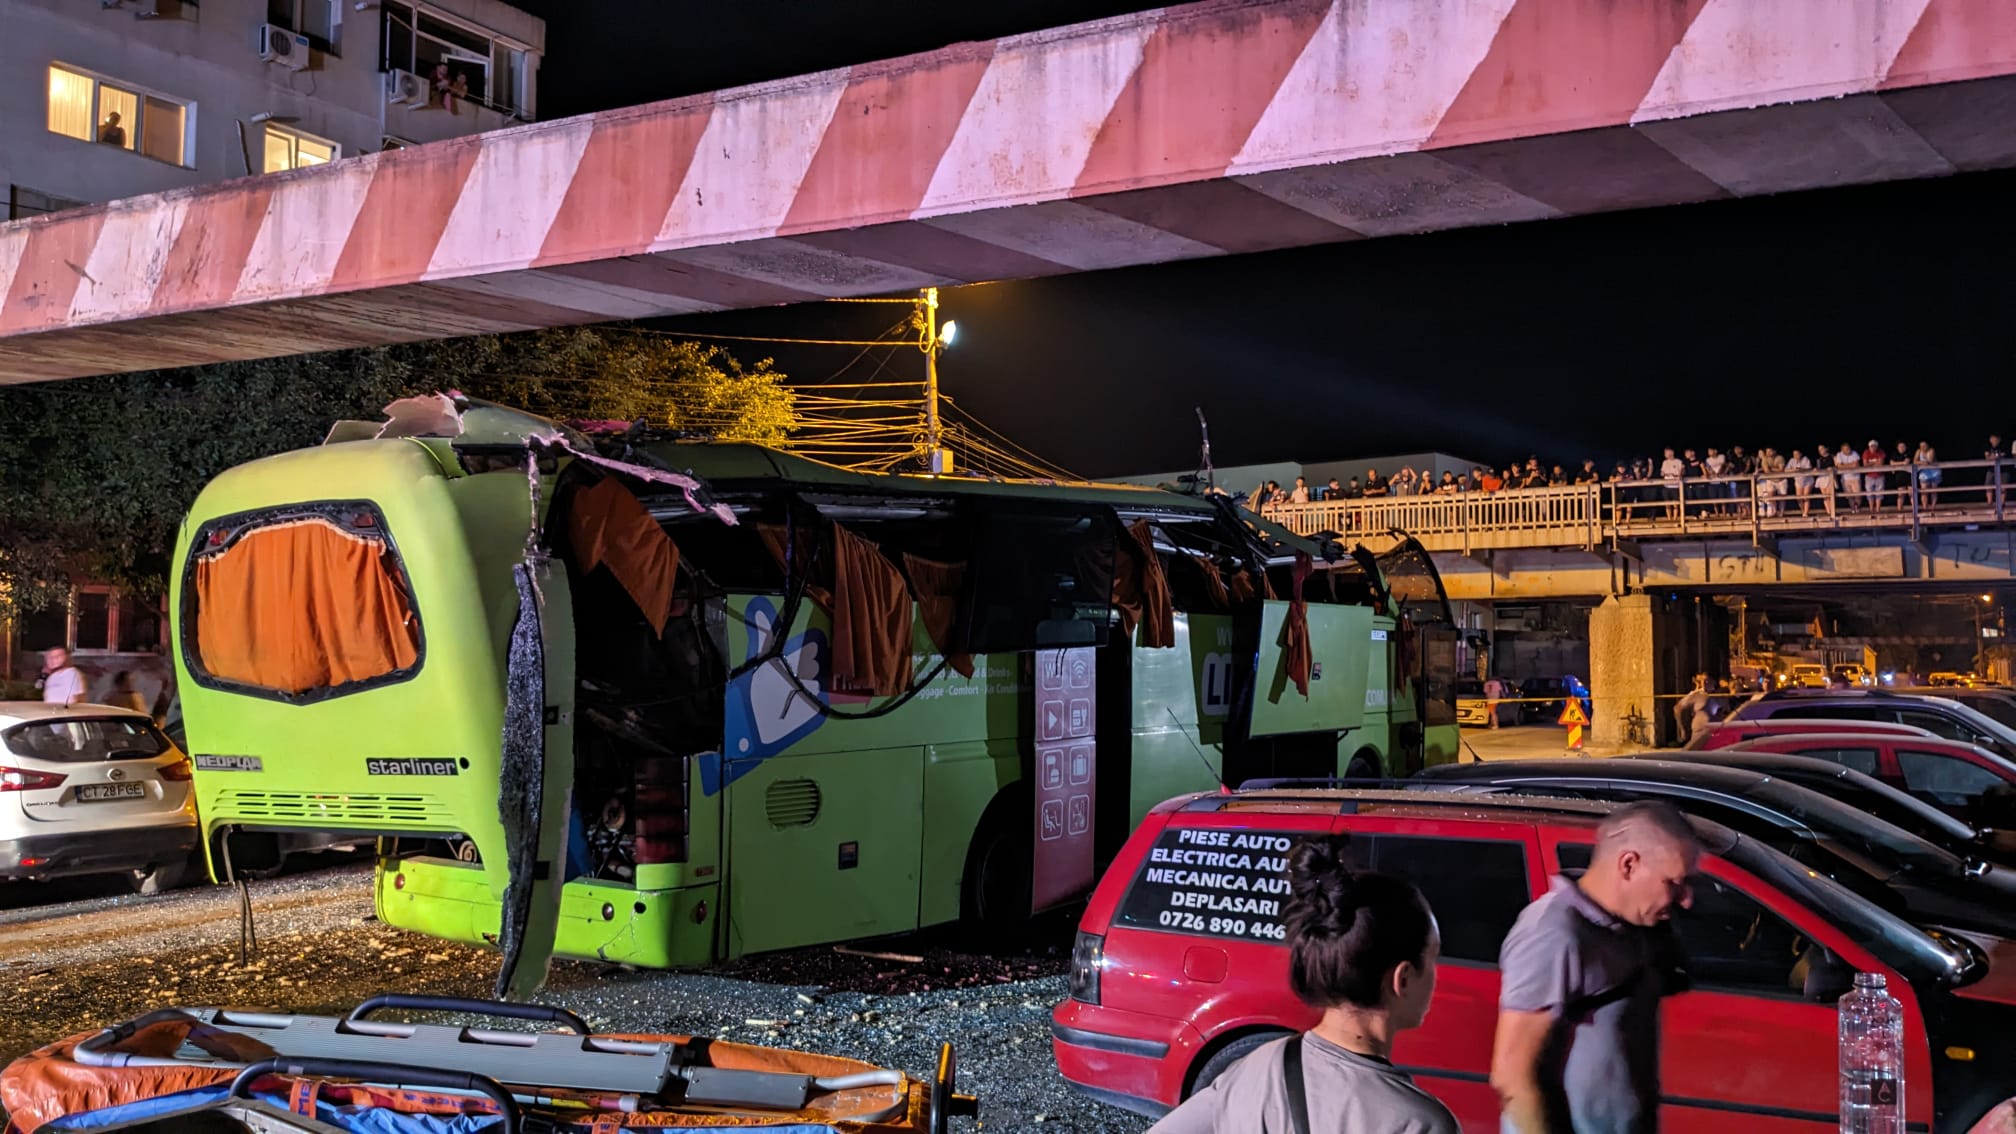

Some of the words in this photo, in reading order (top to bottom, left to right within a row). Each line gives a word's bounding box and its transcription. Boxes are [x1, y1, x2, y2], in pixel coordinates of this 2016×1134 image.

[948, 685, 979, 697] Comfort
[368, 758, 456, 775] starliner
[83, 786, 98, 799] CT
[1179, 830, 1231, 847] PIESE
[1232, 834, 1291, 852] AUTO
[1150, 848, 1252, 870] ELECTRICA
[1254, 856, 1291, 872] AU
[1146, 867, 1249, 891] MECANICA
[1251, 877, 1292, 895] AUT
[1170, 891, 1280, 916] DEPLASARI
[1159, 910, 1205, 931] 0726
[1209, 917, 1246, 935] 890
[1250, 921, 1287, 940] 446
